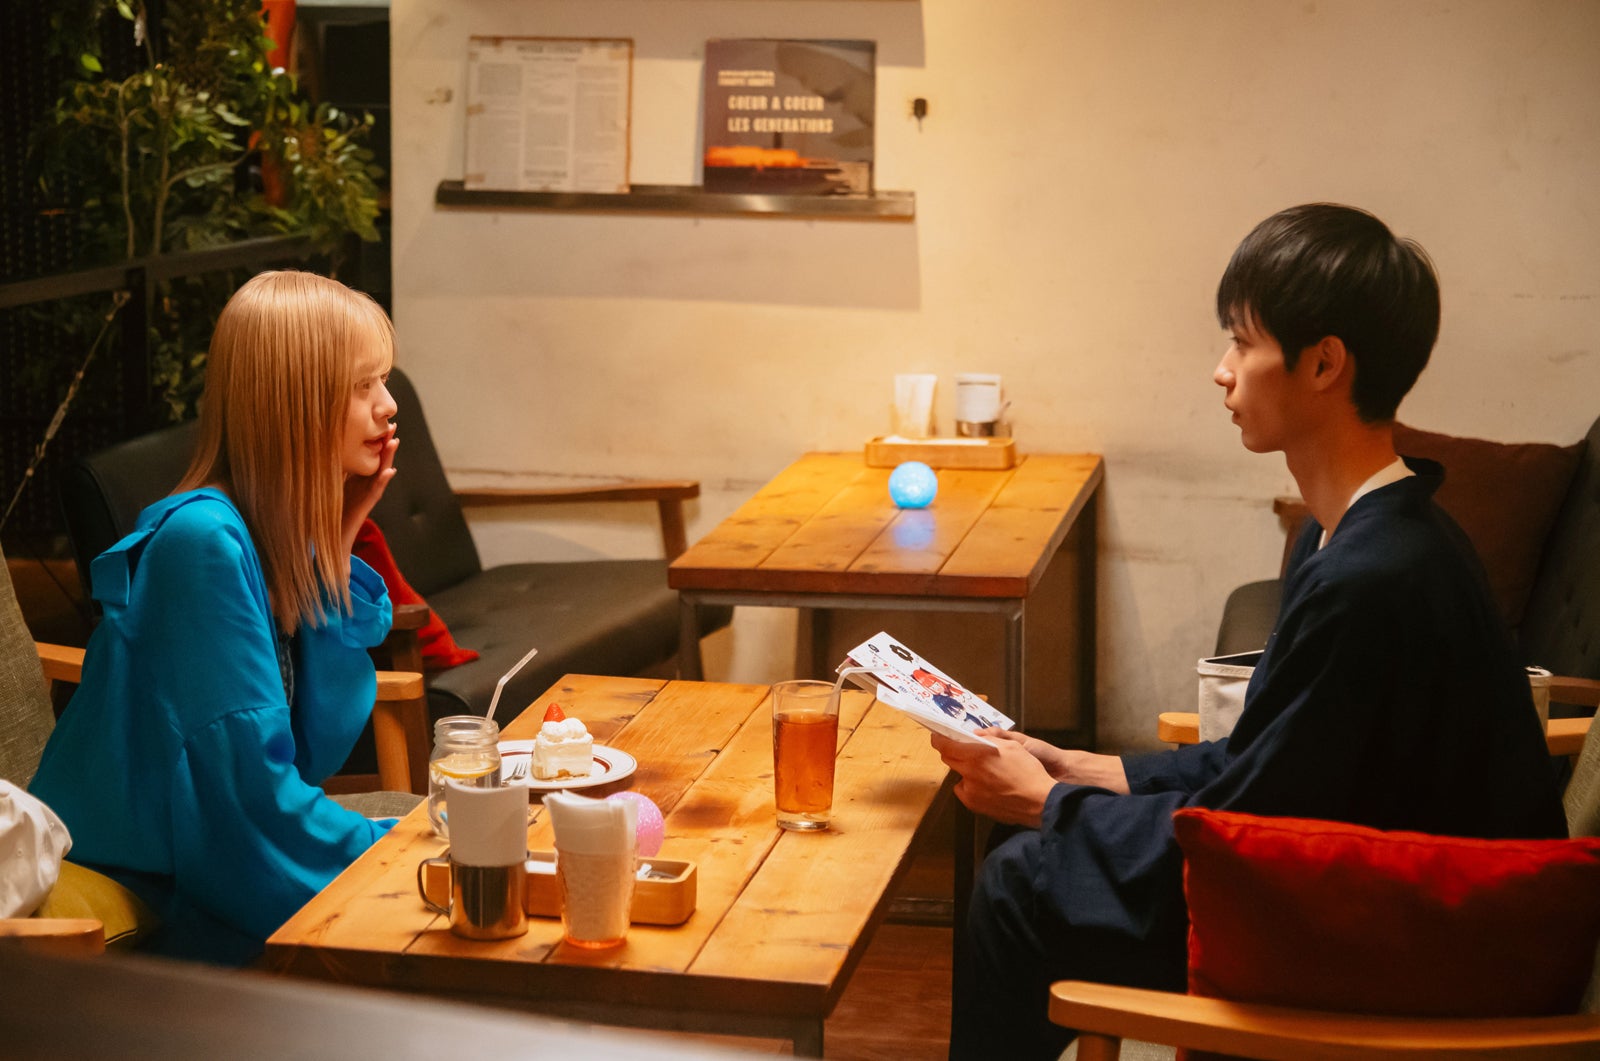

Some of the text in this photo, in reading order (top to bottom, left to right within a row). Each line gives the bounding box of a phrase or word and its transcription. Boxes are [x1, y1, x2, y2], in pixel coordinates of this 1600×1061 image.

[728, 95, 825, 111] COEUR A COEUR
[728, 118, 834, 133] LES GENERATIONS
